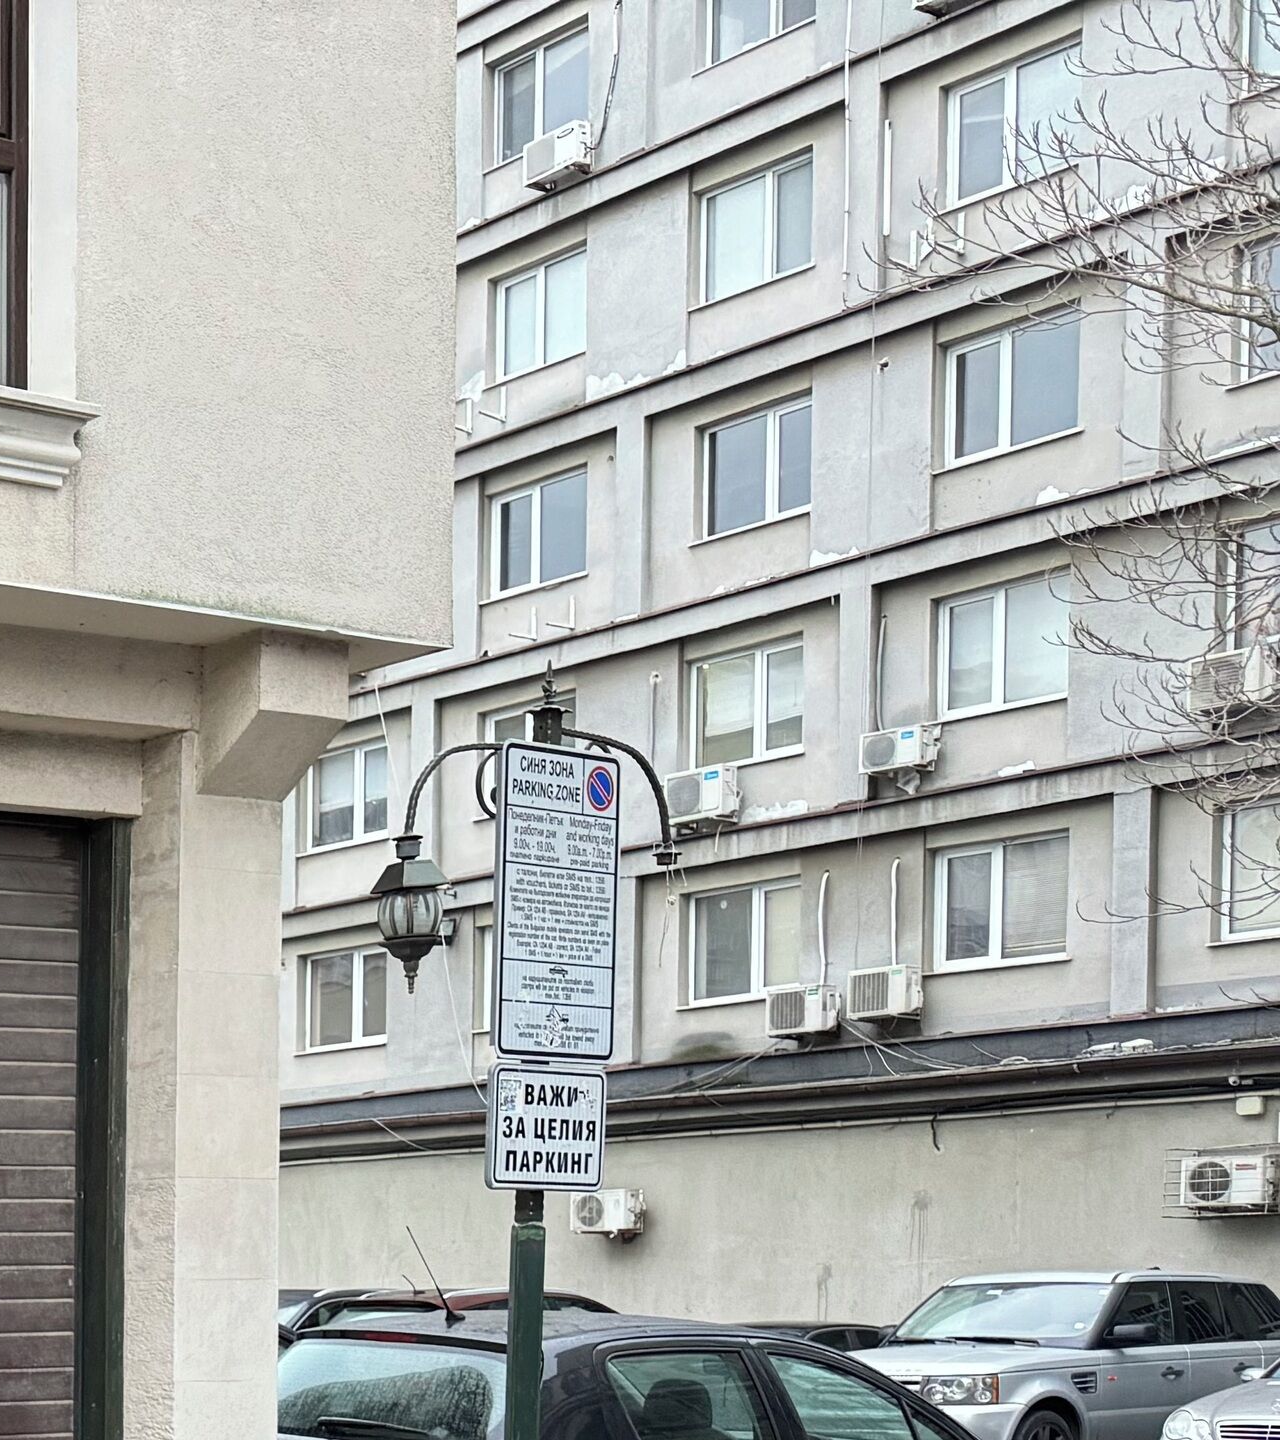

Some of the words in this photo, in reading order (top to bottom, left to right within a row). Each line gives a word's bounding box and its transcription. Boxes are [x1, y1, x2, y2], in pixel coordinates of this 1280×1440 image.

[520, 756, 547, 775] СИНЯ
[549, 760, 575, 779] ЗОНА
[512, 778, 554, 799] PARKING
[555, 784, 581, 803] ZONE
[545, 829, 557, 839] дни
[566, 831, 578, 841] and
[578, 834, 600, 847] working
[601, 836, 615, 849] days
[524, 1083, 578, 1107] ВАЖИ
[502, 1116, 526, 1139] ЗА
[534, 1117, 596, 1144] ЦЕЛИЯ
[505, 1150, 593, 1174] ПАРКИНГ
